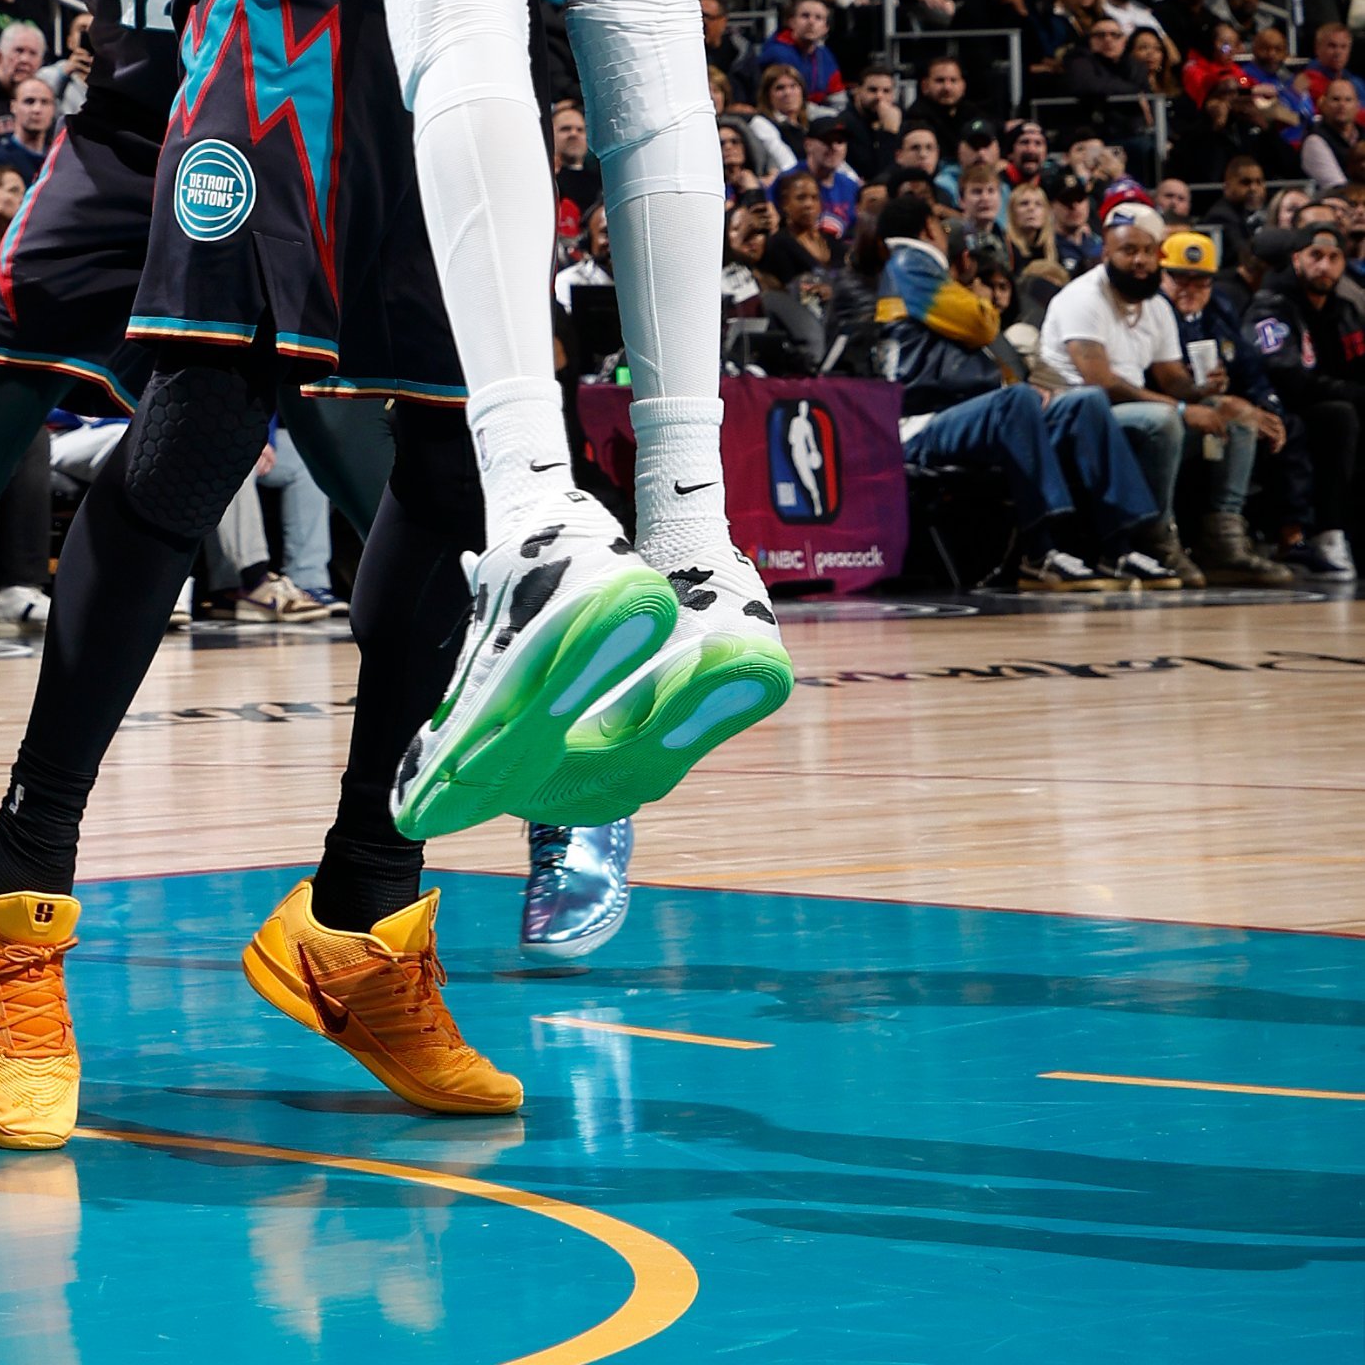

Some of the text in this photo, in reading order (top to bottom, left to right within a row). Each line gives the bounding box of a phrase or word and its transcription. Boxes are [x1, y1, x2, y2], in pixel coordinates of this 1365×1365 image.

[189, 172, 236, 193] DETROIT
[186, 188, 235, 208] PISTONS
[767, 545, 883, 576] NBC peacock
